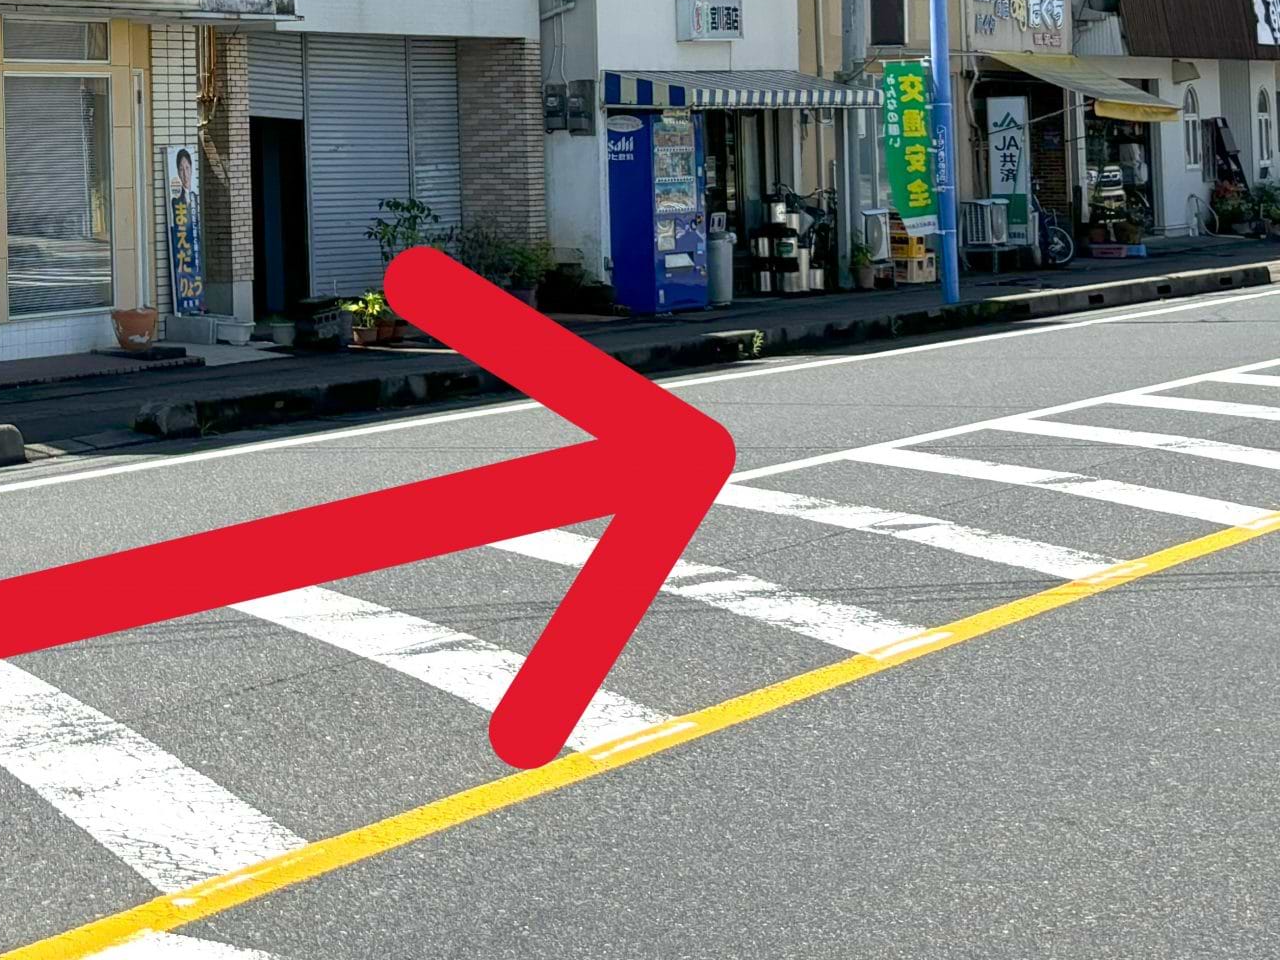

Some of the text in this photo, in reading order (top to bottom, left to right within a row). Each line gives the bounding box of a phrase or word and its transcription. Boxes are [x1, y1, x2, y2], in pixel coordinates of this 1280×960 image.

[608, 136, 635, 153] sahi
[898, 73, 932, 208] 交通安全
